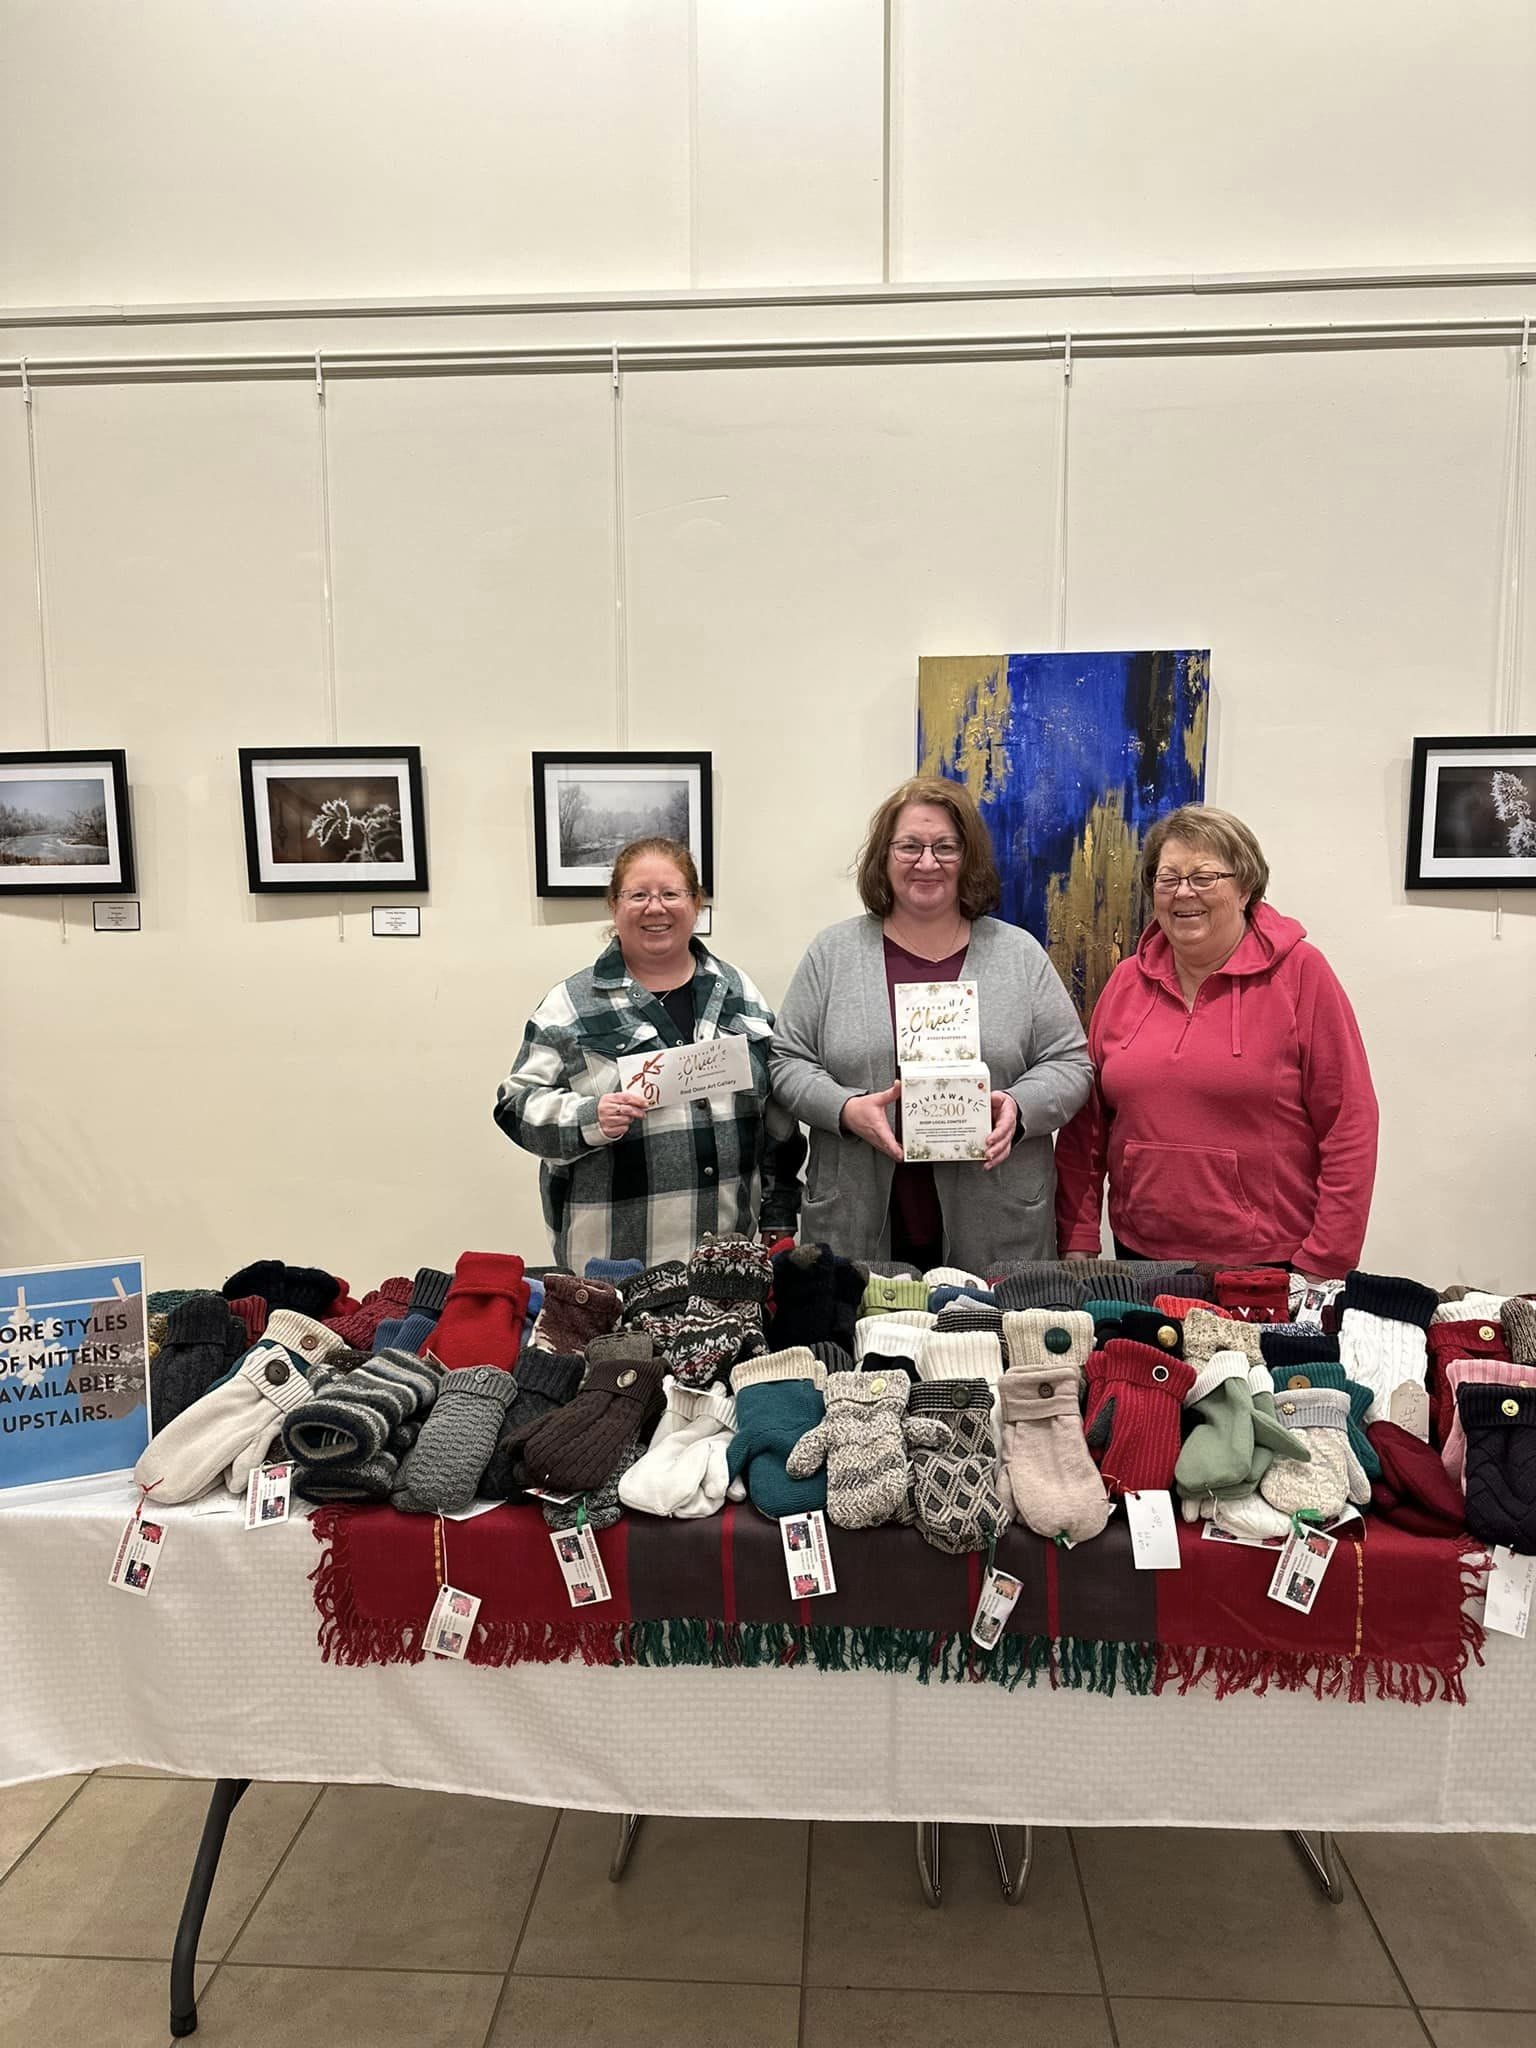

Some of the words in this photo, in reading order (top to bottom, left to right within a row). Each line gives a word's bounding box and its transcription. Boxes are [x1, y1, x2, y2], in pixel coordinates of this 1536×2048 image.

[910, 1007, 960, 1032] Cheer
[717, 1079, 736, 1087] Gallery
[0, 1322, 45, 1344] ORE
[52, 1314, 128, 1338] STYLES
[0, 1356, 20, 1375] OF
[28, 1344, 121, 1371] MITTENS
[0, 1374, 115, 1403] AVAILABLE
[3, 1404, 113, 1434] UPSTAIRS.
